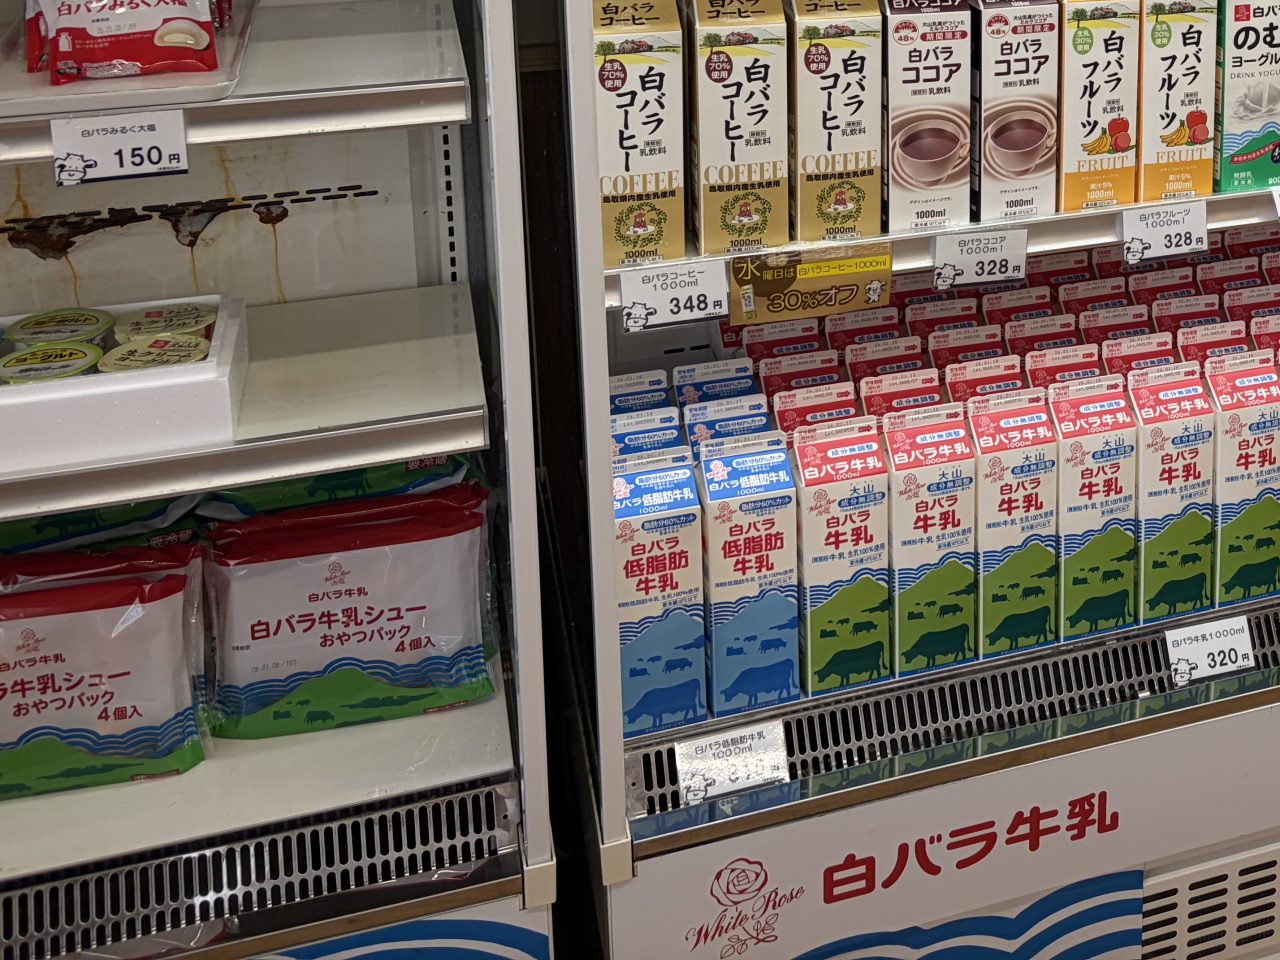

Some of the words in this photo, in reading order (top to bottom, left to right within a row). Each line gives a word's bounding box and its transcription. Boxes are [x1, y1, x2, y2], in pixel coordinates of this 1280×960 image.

[600, 2, 655, 16] 白バラ
[600, 15, 660, 27] コーヒー
[902, 63, 962, 84] ココア
[994, 55, 1050, 76] ココア
[1230, 70, 1255, 80] DRINK
[1080, 60, 1101, 138] フルーツ
[81, 123, 156, 138] 白バラみるく大福
[703, 160, 787, 185] COFFEE
[1077, 155, 1129, 173] FRUIT
[709, 180, 781, 193] 鳥取県内産生乳使用
[1139, 207, 1191, 222] 白バラフルーツ
[958, 236, 1007, 248] 白バラココア
[798, 259, 887, 276] 白バラコーヒー1000ml
[641, 269, 705, 284] 白バラコーヒー
[830, 444, 875, 457] 成分無調整
[708, 469, 790, 492] 白バラ低脂肪牛乳
[623, 550, 690, 579] 低脂肪
[250, 603, 427, 641] 白バラ牛乳シュー
[319, 624, 411, 648] おやつパック
[395, 636, 436, 653] 4個入
[12, 689, 115, 718] おやつパック
[97, 706, 143, 722] 4個入
[822, 790, 1119, 905] 白バラ牛乳
[685, 908, 748, 953] White
[750, 884, 805, 921] Rose
